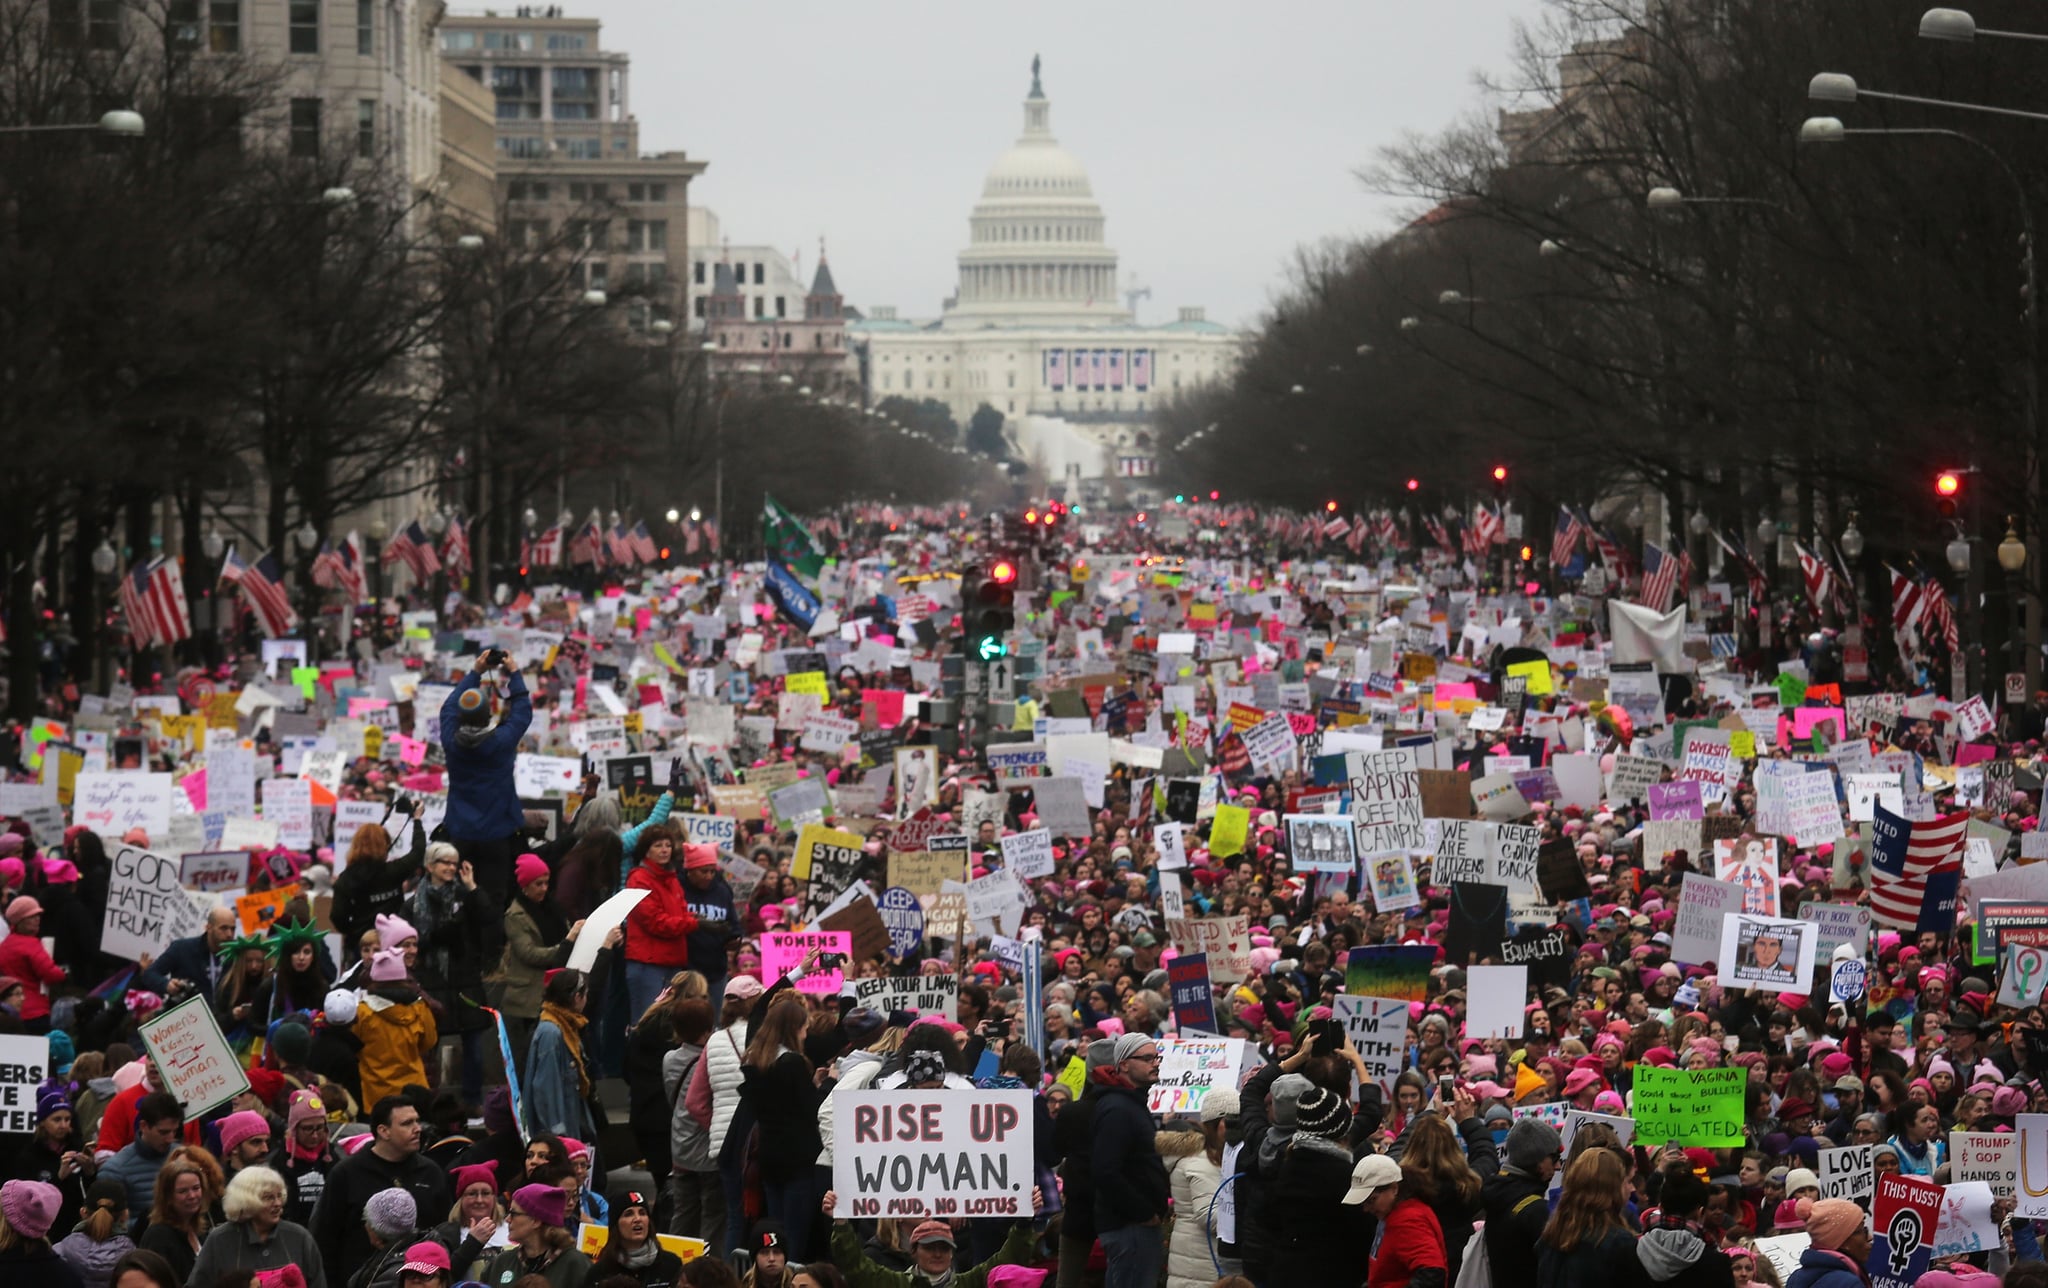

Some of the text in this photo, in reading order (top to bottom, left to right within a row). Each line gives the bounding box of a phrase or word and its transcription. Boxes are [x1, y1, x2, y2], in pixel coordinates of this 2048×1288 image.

[988, 751, 1047, 767] STRONGER
[1689, 741, 1730, 758] DIVERSITY
[1362, 752, 1407, 776] KEEP
[1688, 755, 1725, 770] MAKES
[1683, 767, 1725, 784] AMERICA
[1350, 771, 1420, 801] RAPISTS
[1659, 784, 1686, 798] Yes
[1357, 799, 1420, 826] OFF MY
[1360, 825, 1426, 852] CAMPUS
[1442, 820, 1468, 841] WE
[1497, 825, 1541, 845] NEVER
[813, 844, 862, 865] STOP
[1437, 839, 1466, 857] ARE
[115, 848, 178, 893] GOD
[1437, 857, 1485, 875] CITIZENS
[1498, 860, 1534, 884] BACK
[883, 888, 914, 909] KEEP
[1685, 880, 1728, 899] WOMEN'S
[940, 895, 963, 907] MY
[1683, 893, 1721, 908] RIGHTS
[1681, 915, 1717, 928] HUMAN
[1814, 910, 1851, 923] MY BODY
[1227, 920, 1247, 937] WE
[1680, 925, 1716, 940] RIGHTS
[773, 935, 838, 947] WOMENS
[1501, 931, 1564, 964] EQUALITY
[1840, 962, 1861, 973] KEEP
[855, 977, 886, 1000] KEEP
[890, 976, 921, 994] YOUR
[883, 994, 945, 1013] OFF OUR
[149, 1011, 199, 1045] Women's
[1350, 1016, 1378, 1033] I'M
[160, 1031, 195, 1055] RIGHTS
[171, 1056, 219, 1086] Human
[1688, 1071, 1739, 1085] VAGINA
[182, 1074, 227, 1102] Rights
[1700, 1086, 1742, 1099] BULLETS
[854, 1103, 1019, 1144] RISE UP
[1635, 1120, 1739, 1138] REGULATED
[1969, 1137, 2011, 1149] TRUMP
[1829, 1147, 1871, 1175] LOVE
[1975, 1152, 2002, 1163] GOP
[854, 1152, 1021, 1194] WOMAN.
[1960, 1170, 2001, 1181] HANDS
[1821, 1171, 1872, 1200] NOT HATE
[1882, 1180, 1941, 1209] THIS PUSSY
[853, 1197, 1018, 1219] NO MUD, NO LOTUS
